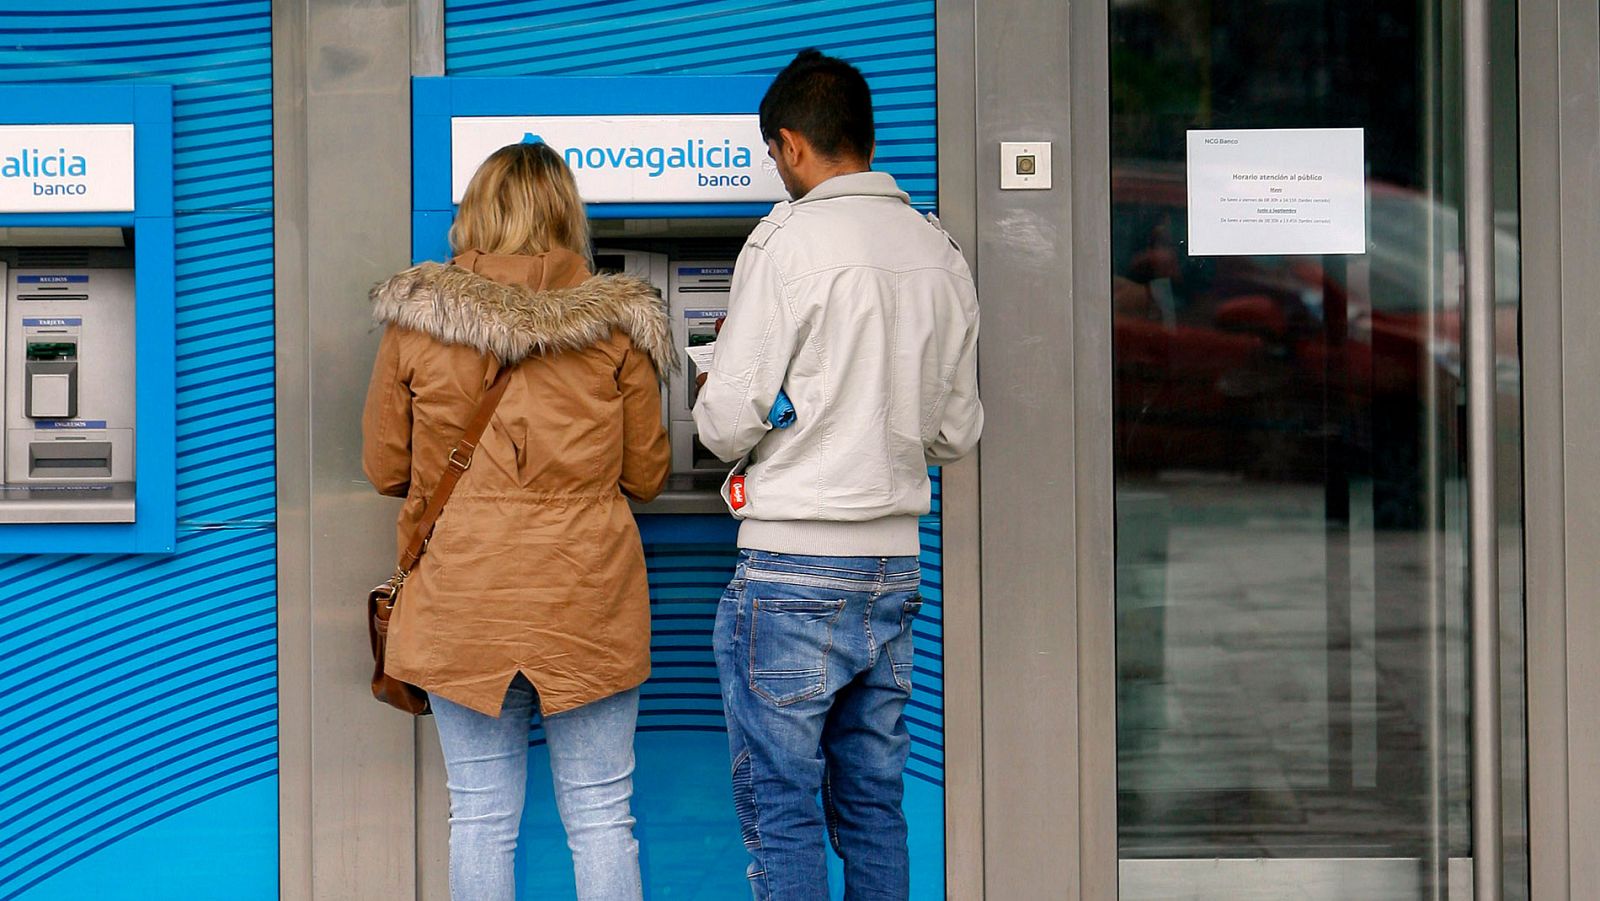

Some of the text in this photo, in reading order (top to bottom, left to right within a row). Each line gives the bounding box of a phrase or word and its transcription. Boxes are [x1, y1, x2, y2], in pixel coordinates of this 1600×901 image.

[564, 139, 751, 177] novagalicia
[698, 172, 751, 187] banco
[1297, 174, 1323, 182] público
[33, 182, 87, 196] banco
